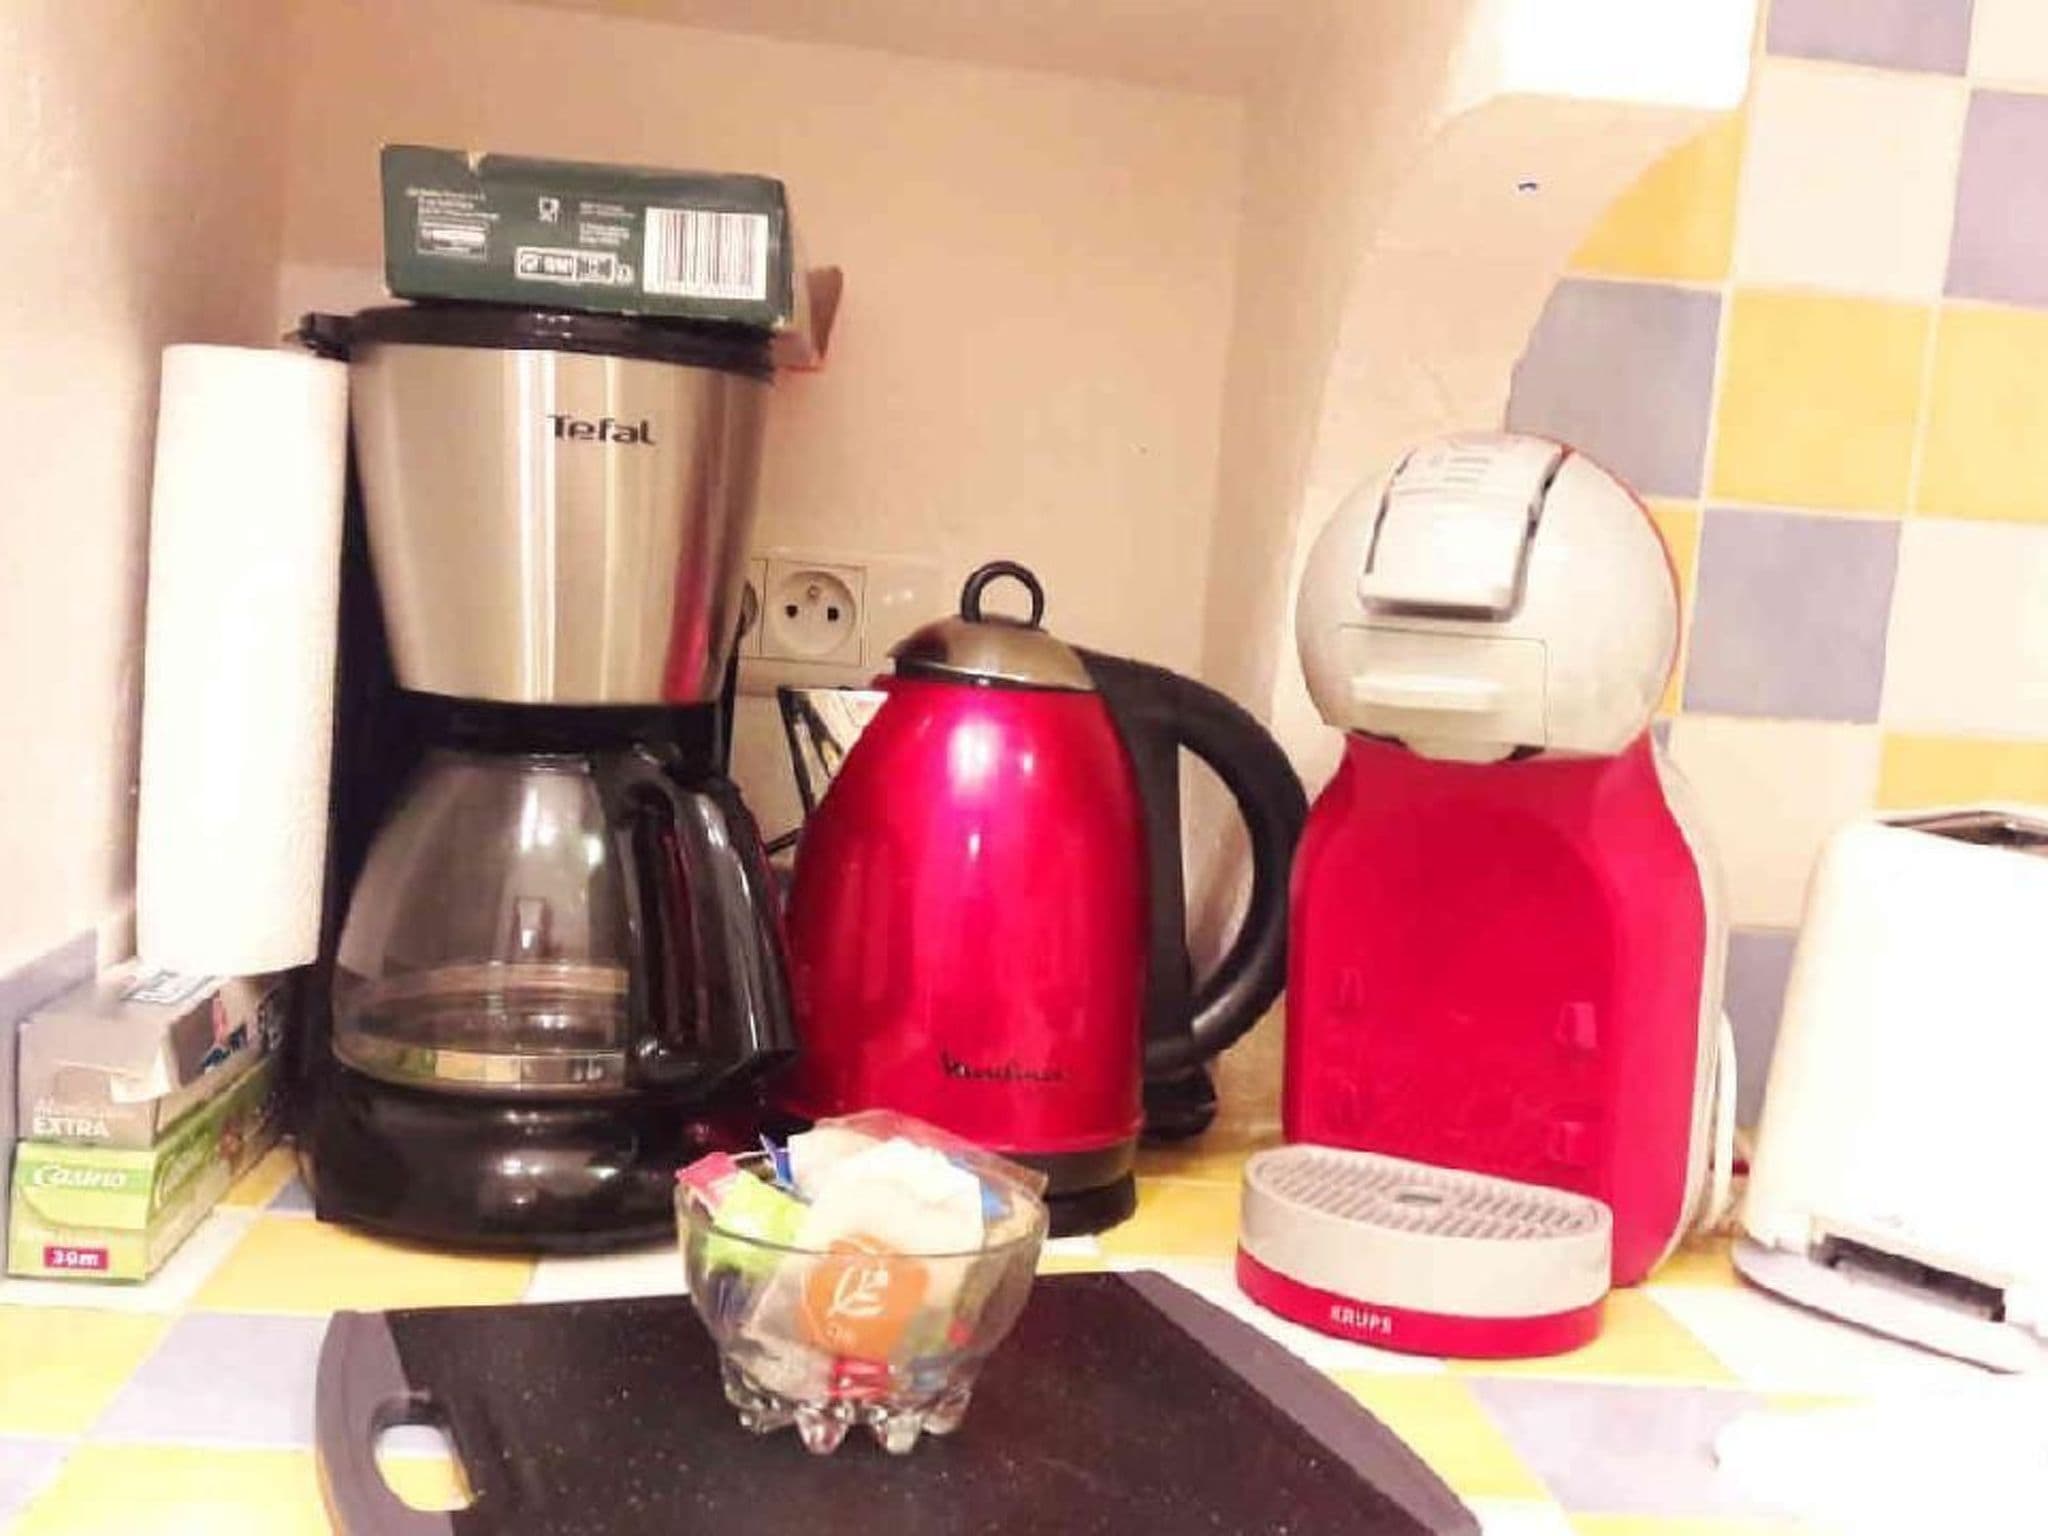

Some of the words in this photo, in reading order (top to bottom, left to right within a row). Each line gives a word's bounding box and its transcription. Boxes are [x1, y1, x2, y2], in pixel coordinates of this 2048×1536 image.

[547, 413, 656, 446] Tefal
[33, 1118, 110, 1137] EXTRA
[1330, 1304, 1392, 1335] KRUPS
